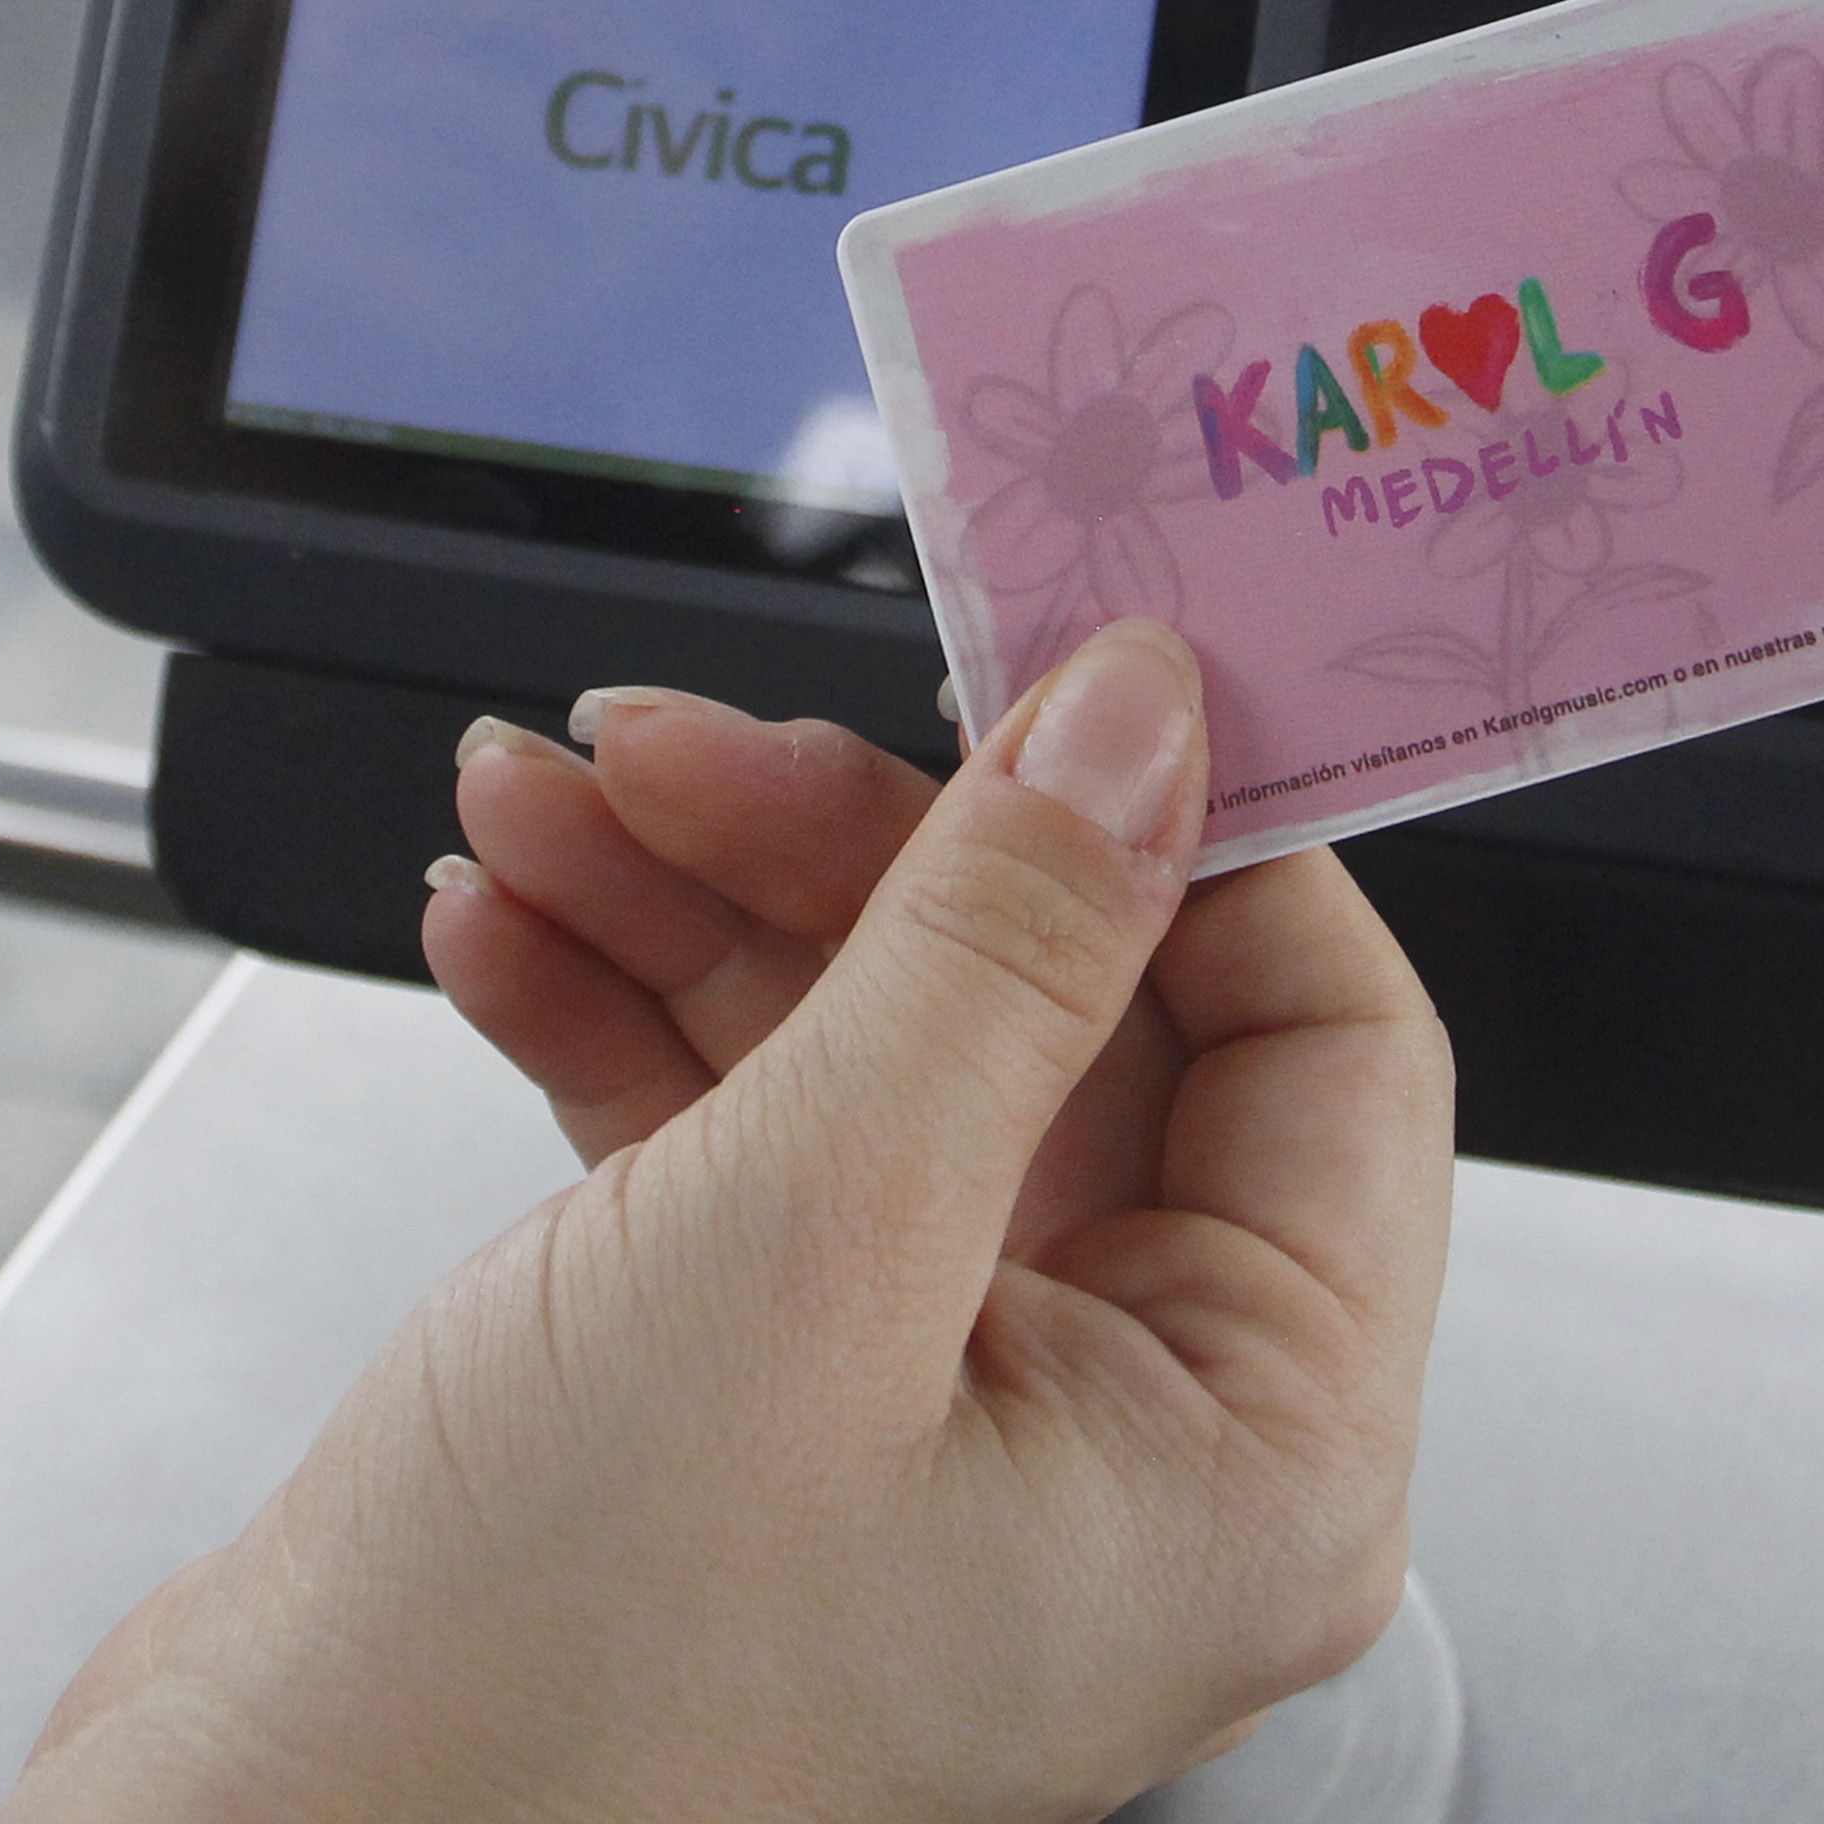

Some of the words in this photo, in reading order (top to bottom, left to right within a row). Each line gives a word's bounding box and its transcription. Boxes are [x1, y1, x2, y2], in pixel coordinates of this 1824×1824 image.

[1637, 211, 1751, 354] G
[1221, 762, 1347, 811] información
[1349, 735, 1447, 775] visítanos
[1452, 725, 1479, 746] en
[1482, 671, 1669, 739] Karolgmusic.com
[1673, 667, 1688, 683] o
[1691, 656, 1721, 679] en
[1723, 628, 1818, 668] nuestras
